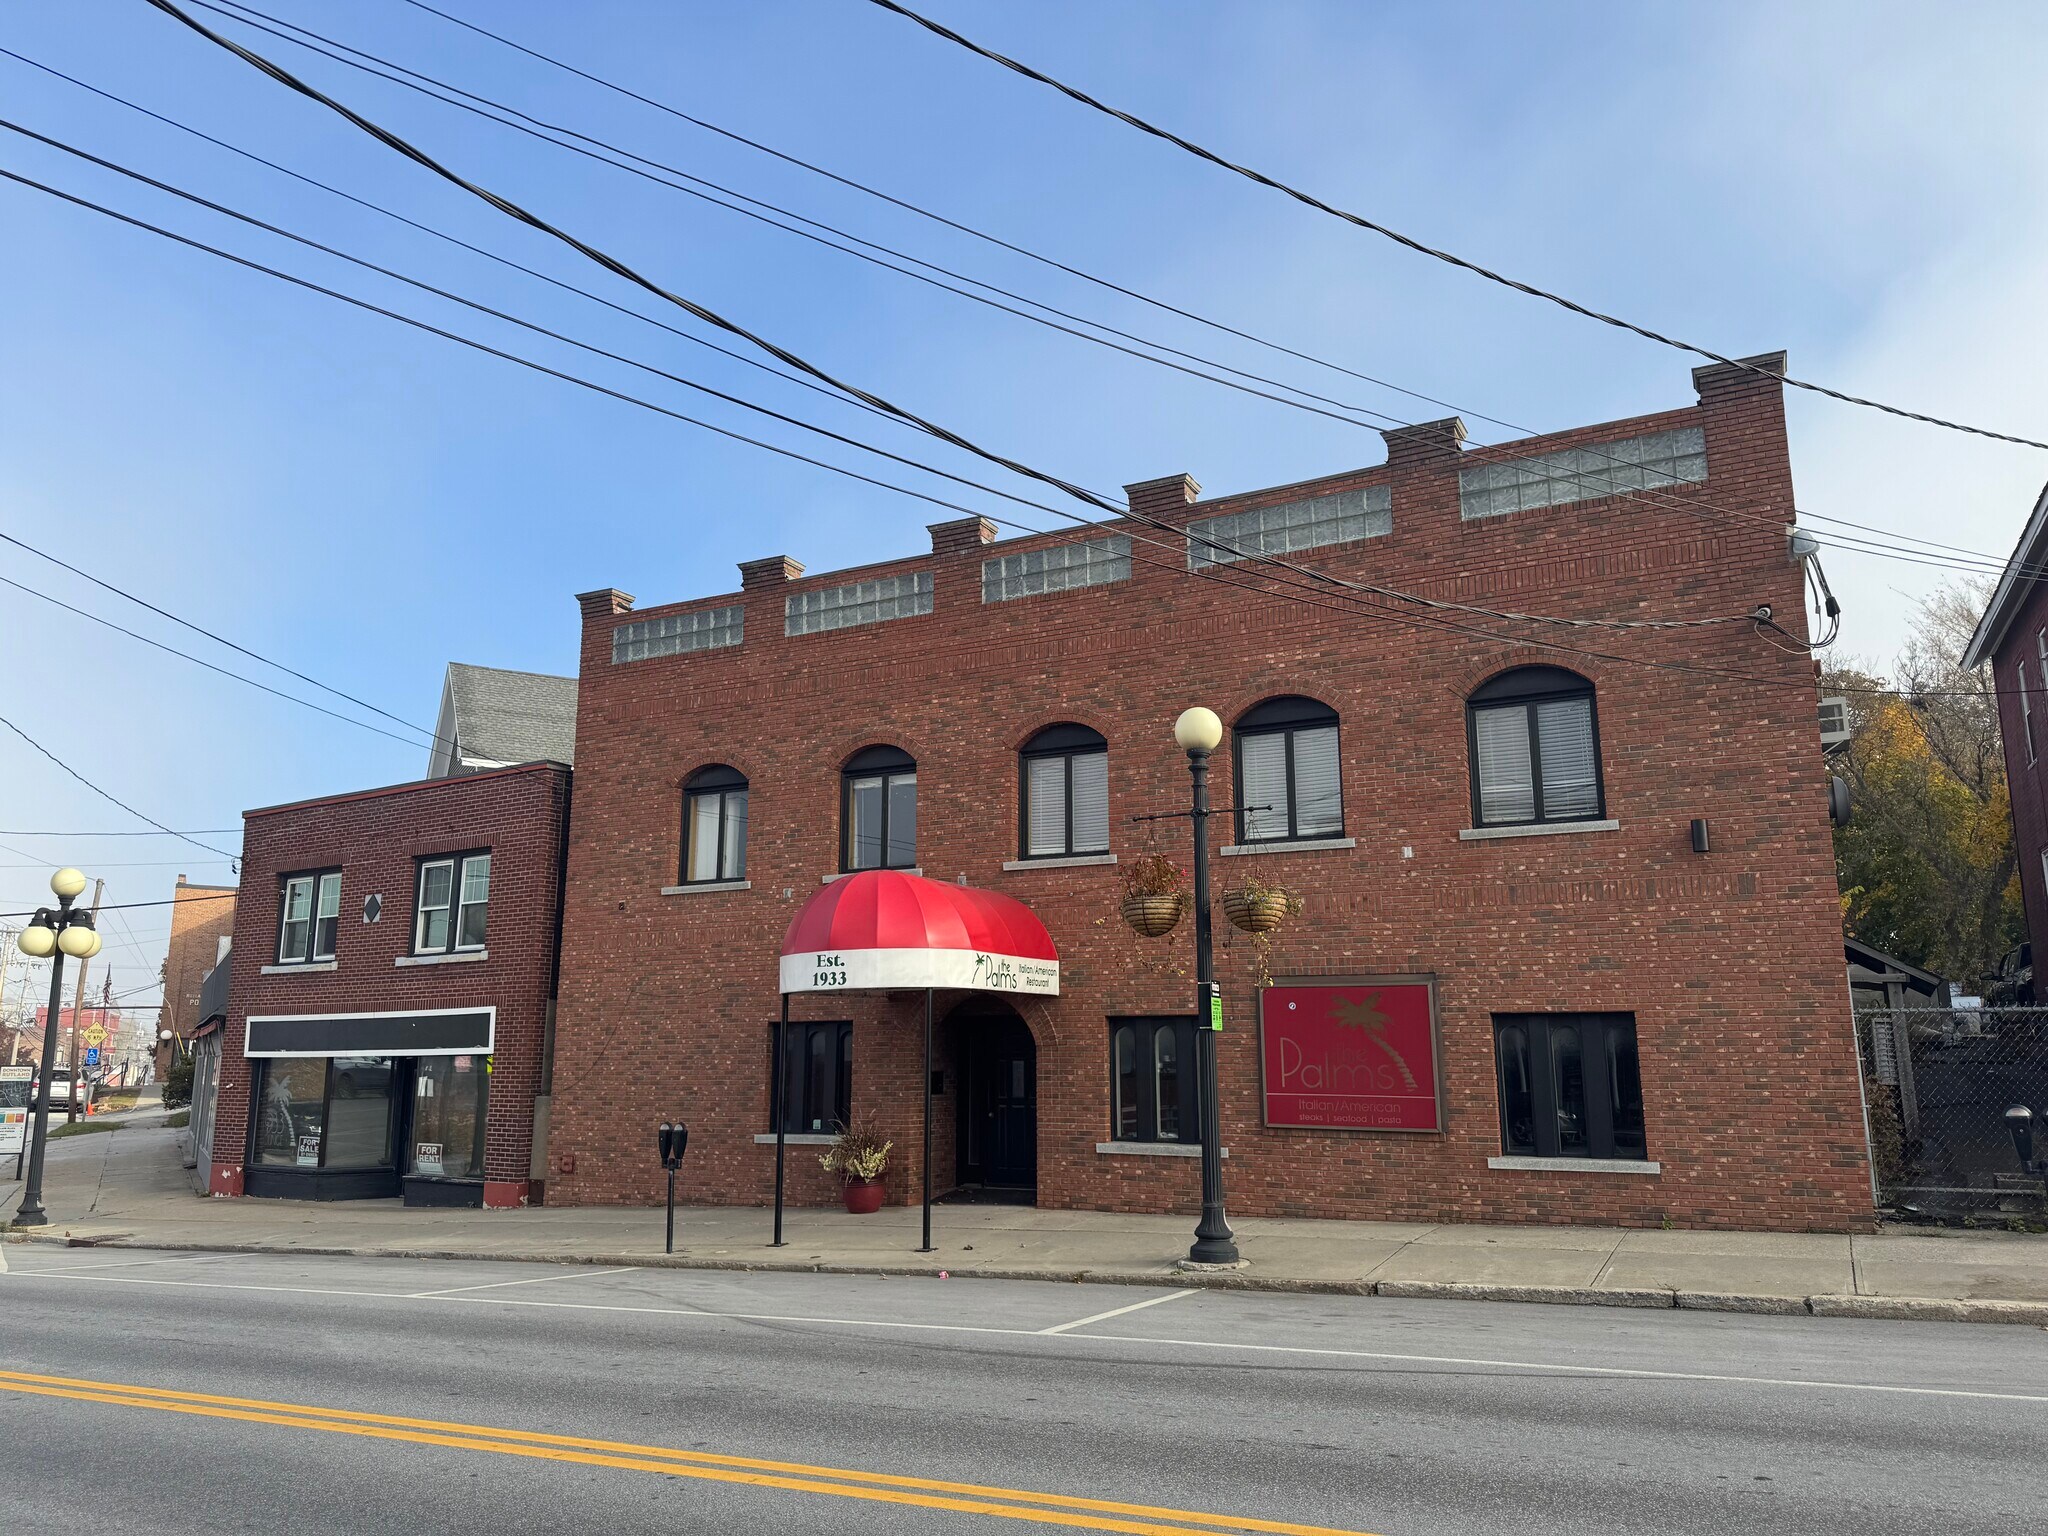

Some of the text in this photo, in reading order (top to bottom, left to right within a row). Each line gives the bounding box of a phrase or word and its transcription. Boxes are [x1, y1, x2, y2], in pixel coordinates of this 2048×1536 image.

[817, 954, 845, 967] Est.
[1001, 959, 1011, 972] the
[986, 955, 1017, 989] Palms
[1019, 964, 1057, 976] Italian/American
[812, 971, 847, 986] 1933
[1026, 977, 1049, 987] Restaurant
[1336, 1041, 1368, 1062] the
[1280, 1037, 1395, 1089] Palms
[1299, 1099, 1401, 1113] Italian/American
[1299, 1113, 1401, 1124] steaks seafood pasta
[300, 1145, 319, 1153] SALE
[421, 1146, 437, 1154] FOR
[419, 1155, 439, 1163] RENT
